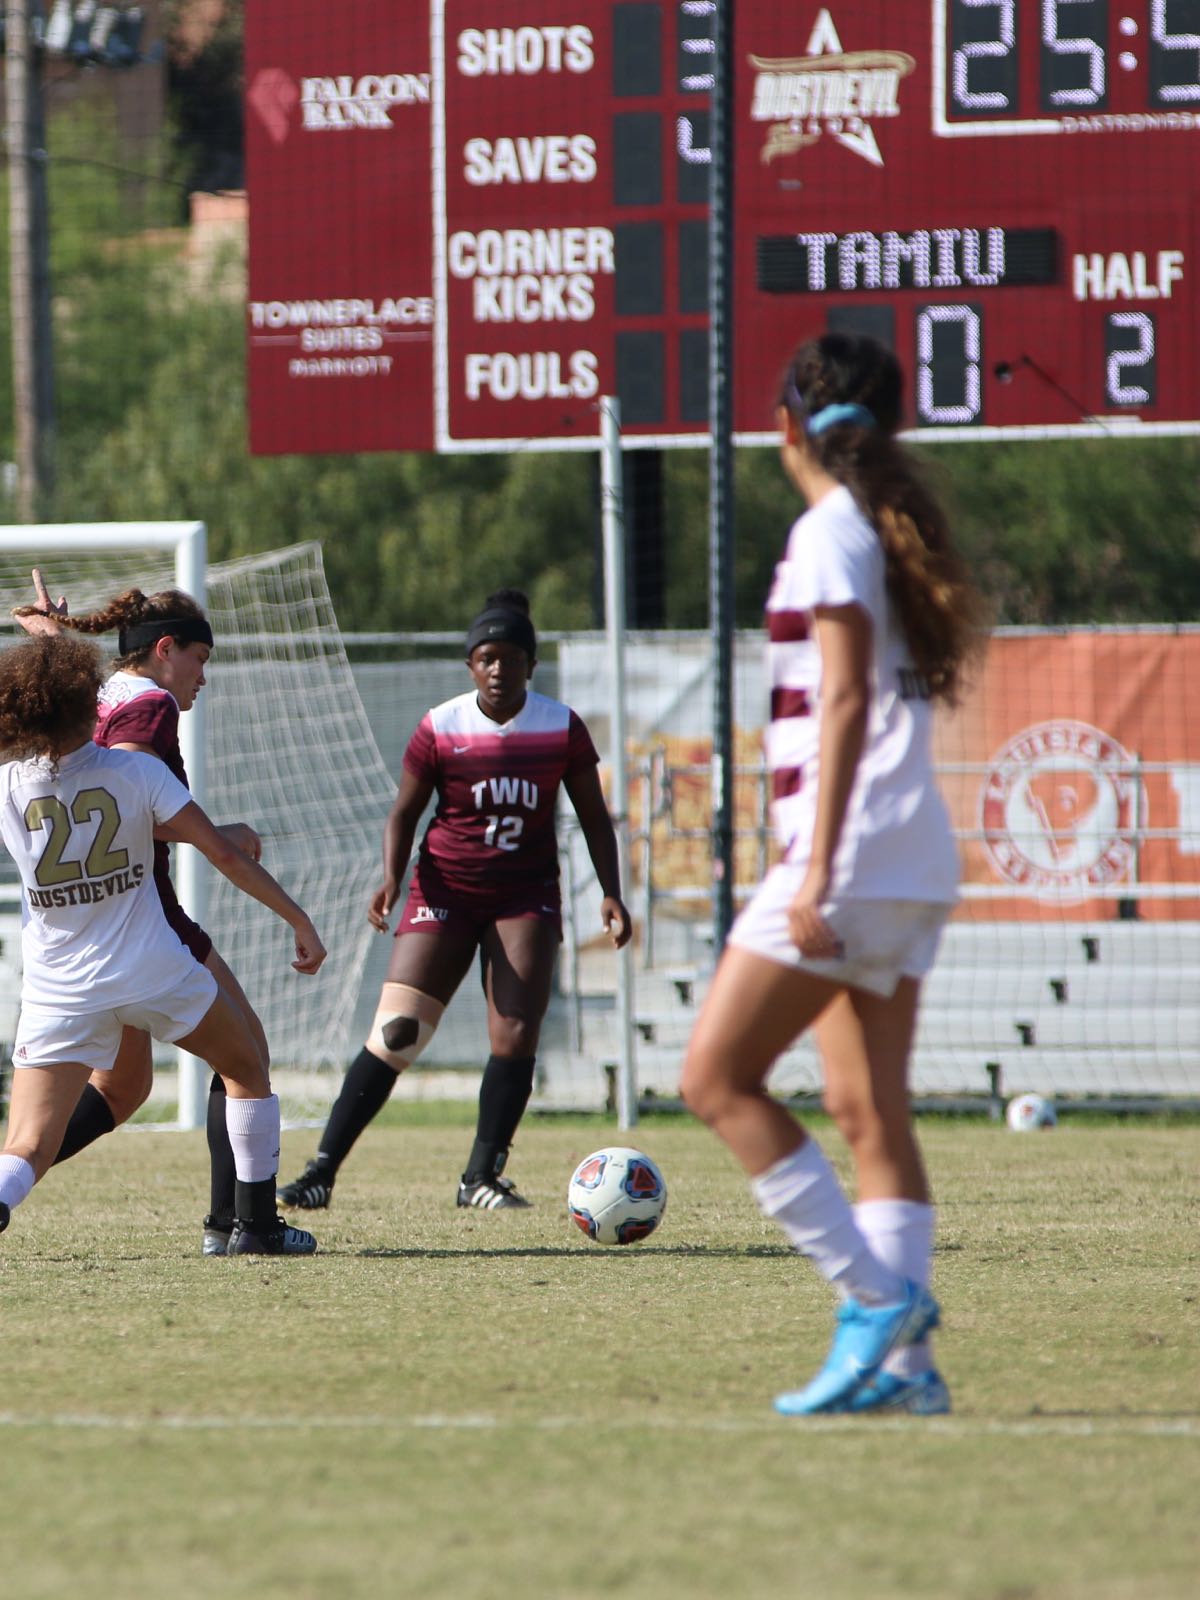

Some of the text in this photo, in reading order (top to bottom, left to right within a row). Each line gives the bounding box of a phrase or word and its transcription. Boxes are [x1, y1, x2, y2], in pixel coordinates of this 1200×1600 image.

[456, 24, 596, 77] SHOTS
[301, 73, 433, 104] FALCON
[302, 101, 394, 131] BANK
[463, 134, 598, 185] SAVES
[448, 227, 616, 280] CORNER
[797, 226, 1005, 291] TAMIU
[1072, 250, 1184, 301] HALF
[250, 296, 434, 329] TOWNEPLACE
[473, 274, 596, 323] KICKS
[301, 326, 384, 352] SUITES
[916, 304, 981, 424] 0
[1106, 311, 1155, 404] 2
[464, 350, 600, 401] FOULS
[471, 776, 538, 810] TWU
[23, 786, 129, 887] 22
[483, 815, 523, 851] 12
[27, 863, 144, 909] DUSTDEVILS
[415, 905, 449, 920] TWU
